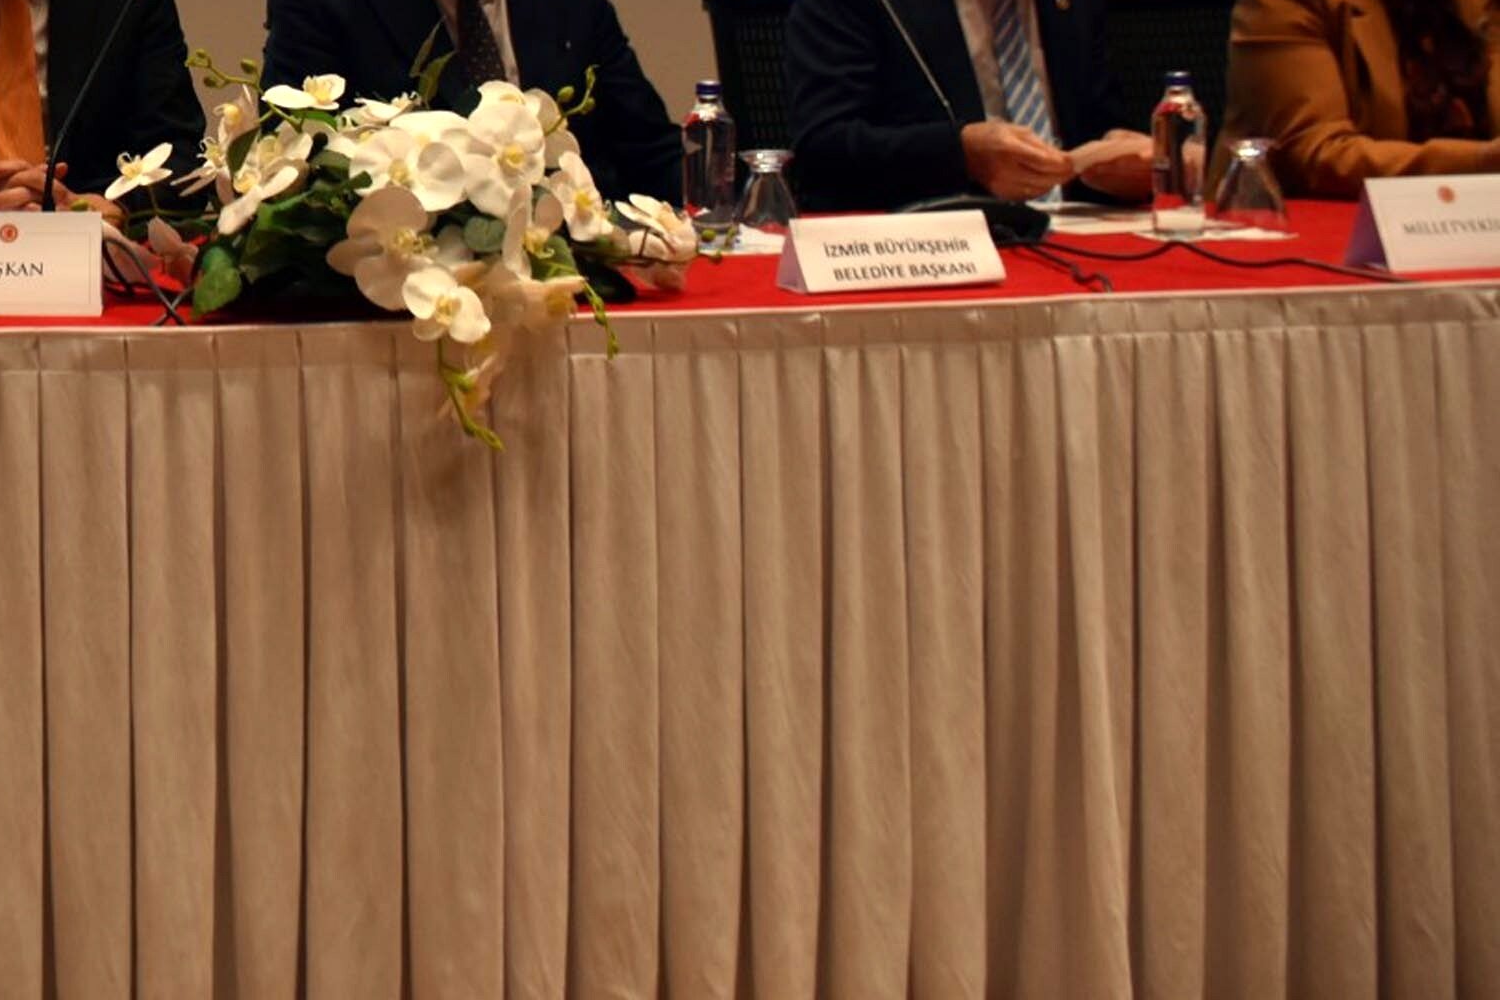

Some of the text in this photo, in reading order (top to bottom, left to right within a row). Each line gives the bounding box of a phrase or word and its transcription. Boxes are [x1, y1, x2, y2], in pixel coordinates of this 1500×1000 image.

[823, 238, 970, 259] İZMİR BÜYÜKŞEHİR
[833, 263, 977, 282] BELEDİYE BAŞKANI
